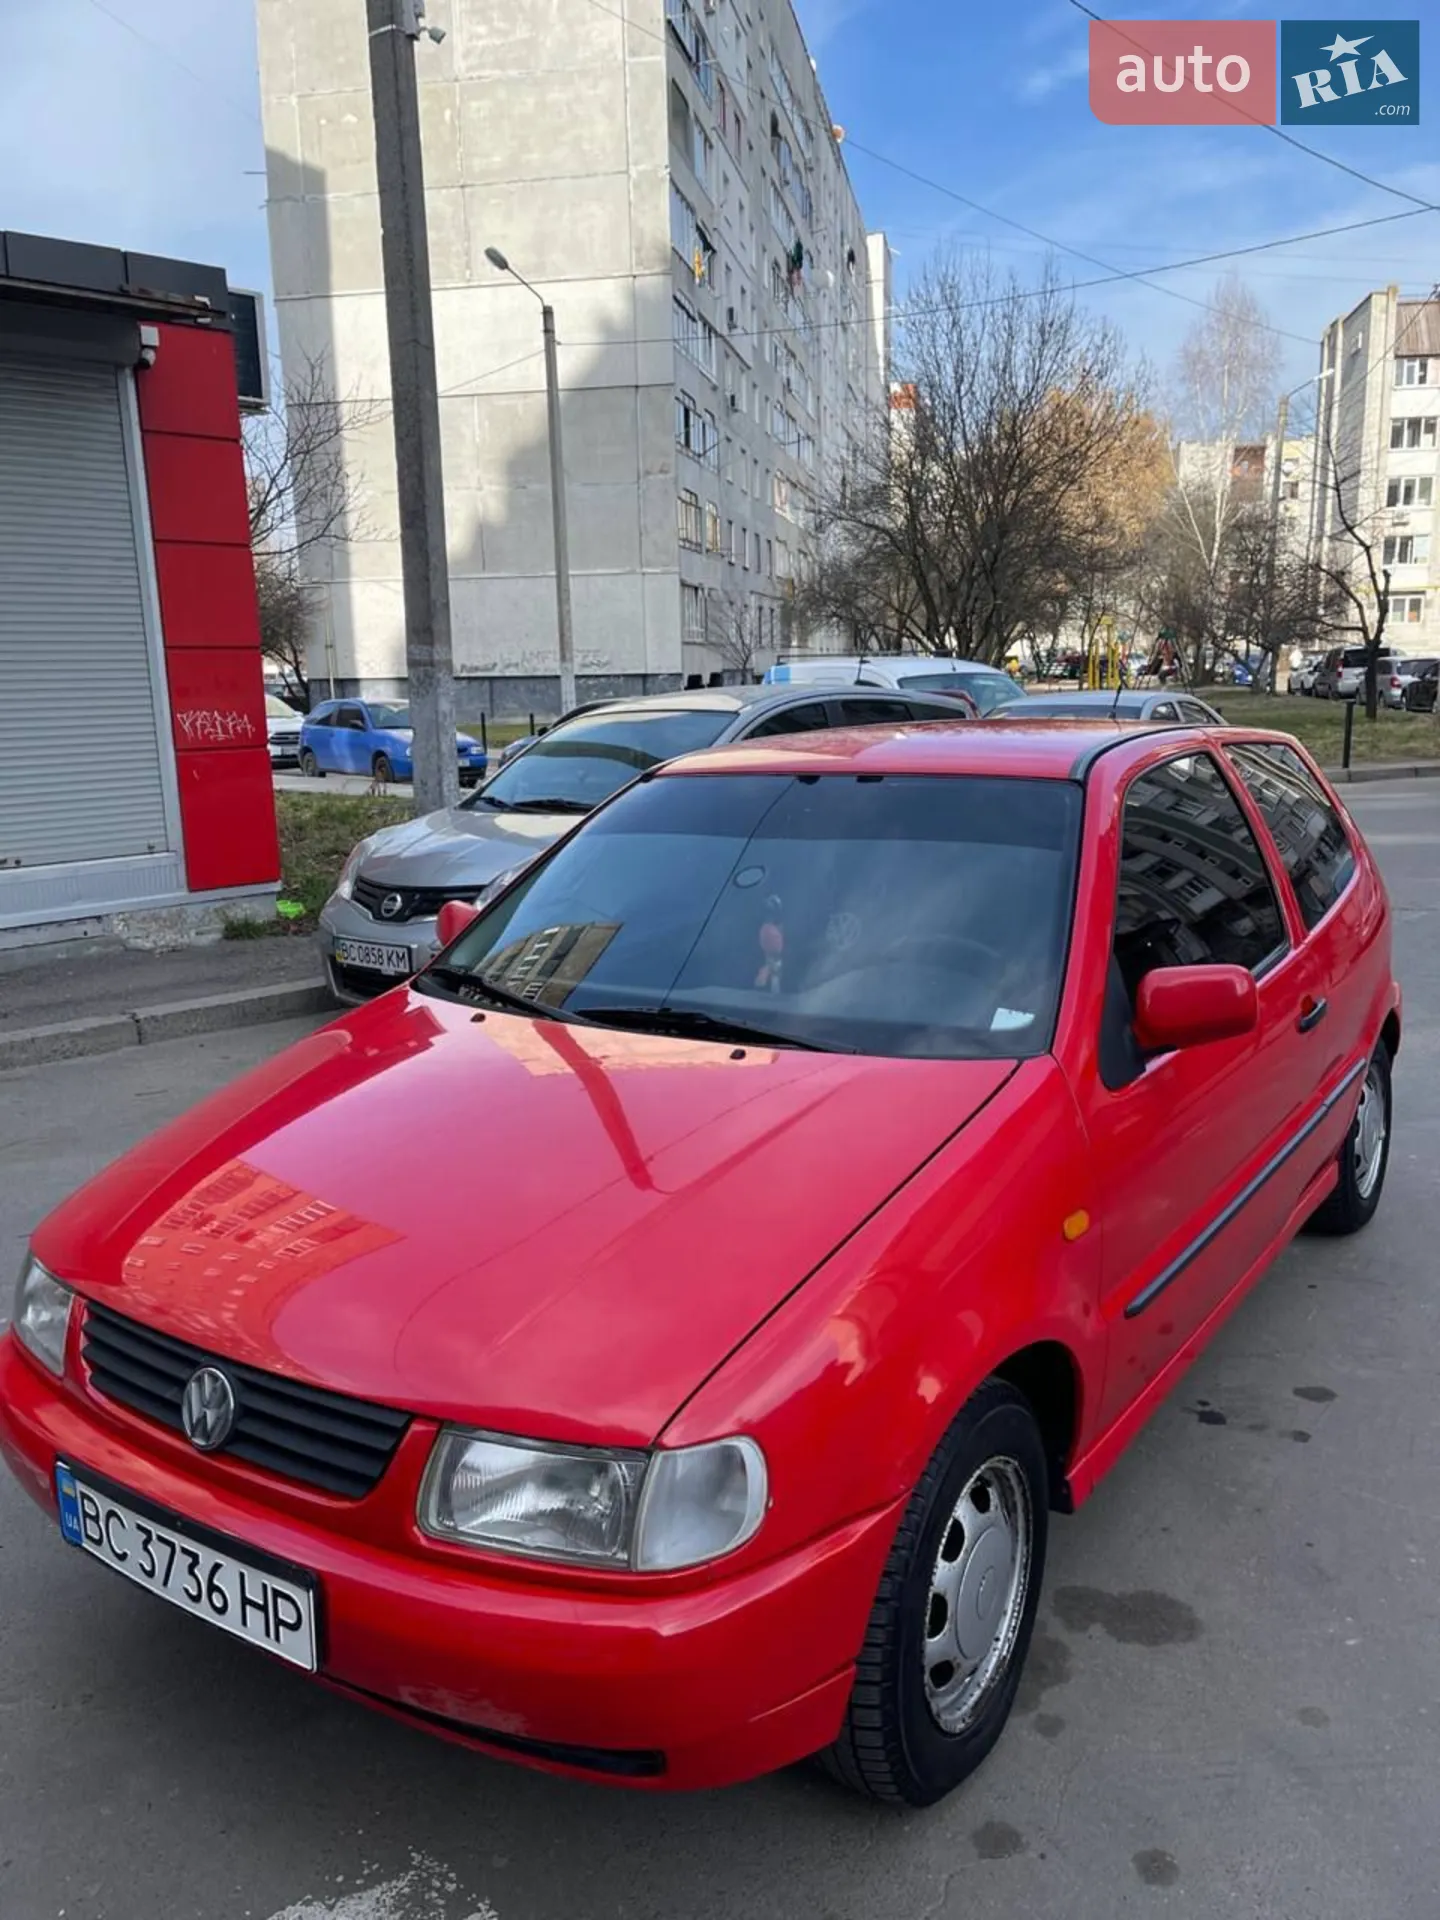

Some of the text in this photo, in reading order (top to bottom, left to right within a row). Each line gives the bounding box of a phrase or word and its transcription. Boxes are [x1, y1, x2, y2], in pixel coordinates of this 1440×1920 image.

[341, 942, 407, 969] BC 0858 KM
[65, 1511, 80, 1532] UA
[79, 1489, 304, 1644] BC 3736 HP
